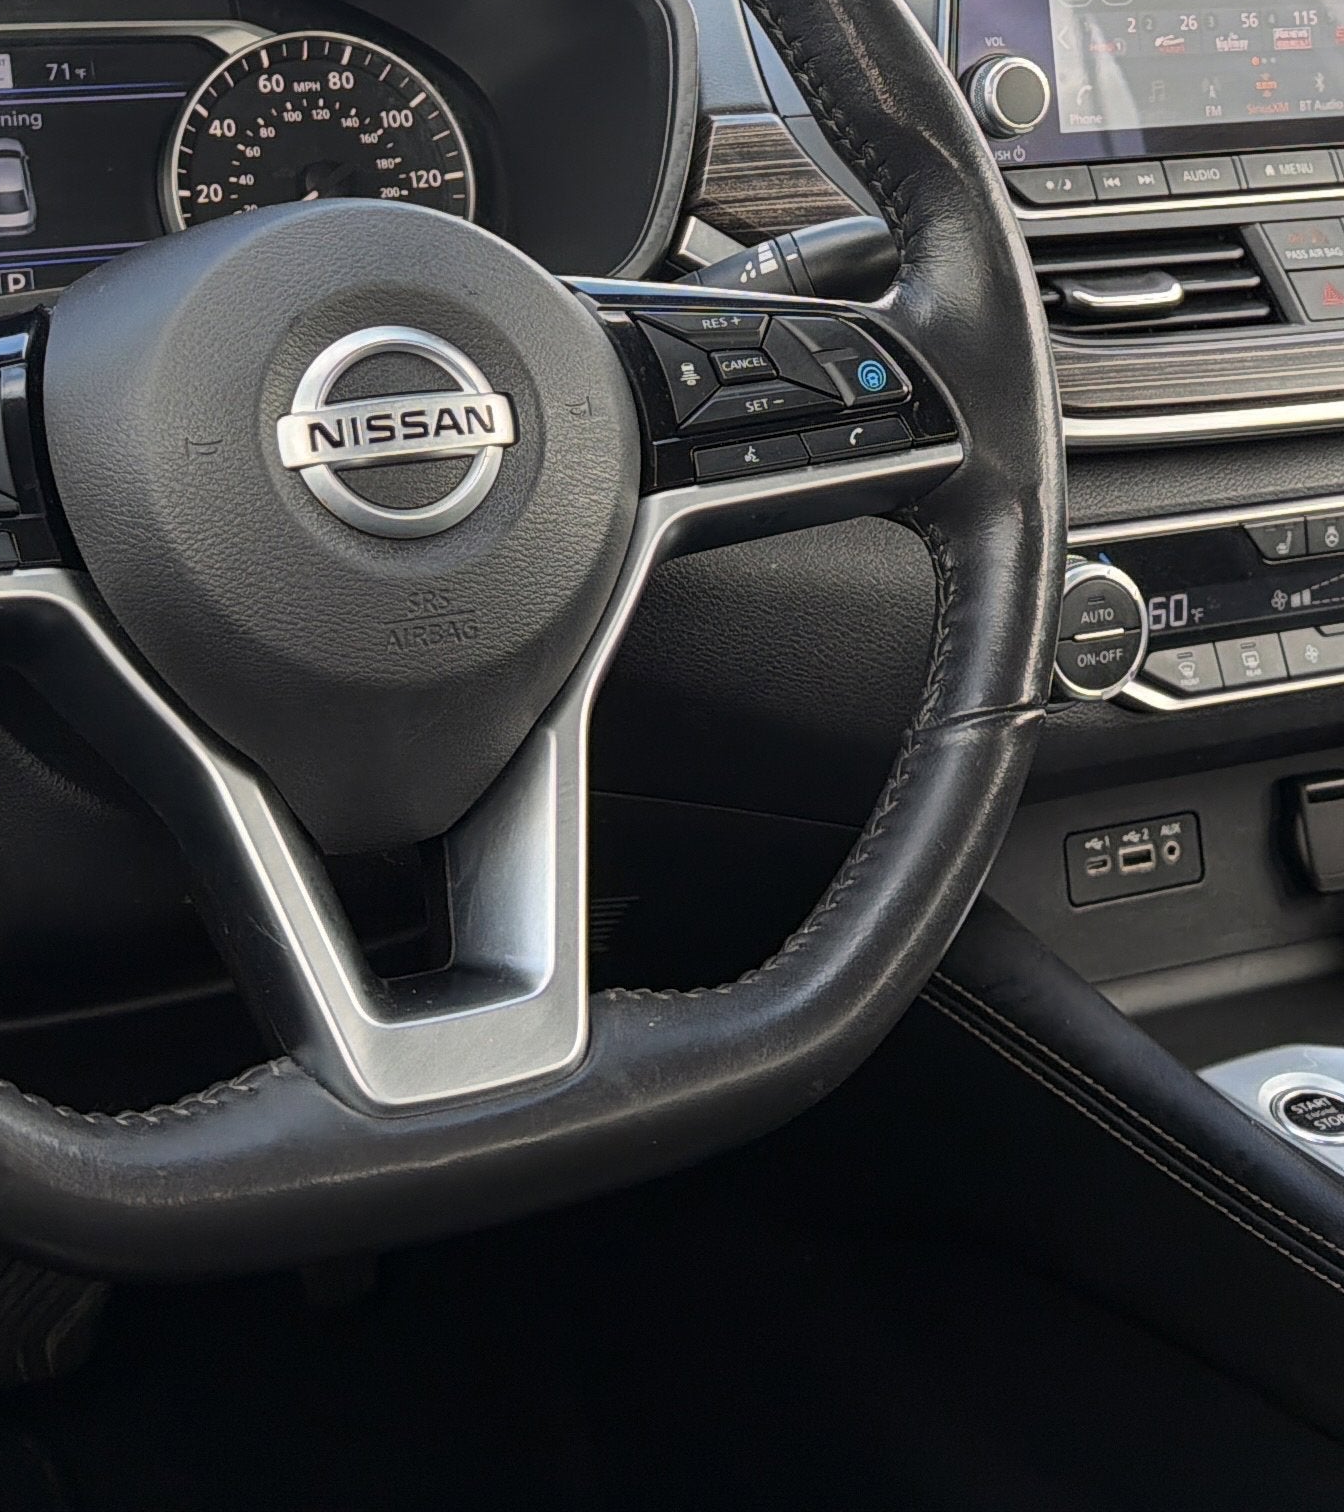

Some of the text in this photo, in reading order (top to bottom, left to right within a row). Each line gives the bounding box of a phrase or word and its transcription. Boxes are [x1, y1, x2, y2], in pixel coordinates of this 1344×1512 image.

[1127, 17, 1137, 34] 2
[1179, 15, 1198, 32] 26
[1240, 12, 1259, 29] 56
[1293, 10, 1318, 27] 115
[984, 36, 1005, 46] VOL
[258, 71, 355, 93] 60 MPH 80
[1205, 105, 1222, 117] FM
[1299, 97, 1344, 112] BT Audio
[283, 109, 360, 129] 100 120 140
[380, 109, 413, 129] 100
[1069, 113, 1103, 127] Phone
[209, 118, 236, 138] 40
[259, 126, 276, 138] 80
[359, 132, 379, 144] 160
[245, 146, 261, 158] 60
[376, 158, 395, 169] 180
[1278, 162, 1314, 177] MENU
[238, 174, 254, 186] 40
[409, 169, 442, 188] 120
[1183, 167, 1220, 184] AUDIO
[196, 184, 223, 204] 20
[380, 187, 400, 198] 200
[1285, 246, 1344, 260] PASS AIR BAG
[8, 273, 26, 293] P
[721, 356, 768, 373] CANCEL
[745, 398, 769, 413] SET
[308, 404, 496, 453] NISSAN
[404, 590, 451, 618] SRS
[1080, 607, 1115, 625] AUTO
[383, 618, 480, 653] AIRBAG
[1160, 821, 1182, 837] AUX
[1291, 1097, 1332, 1115] START
